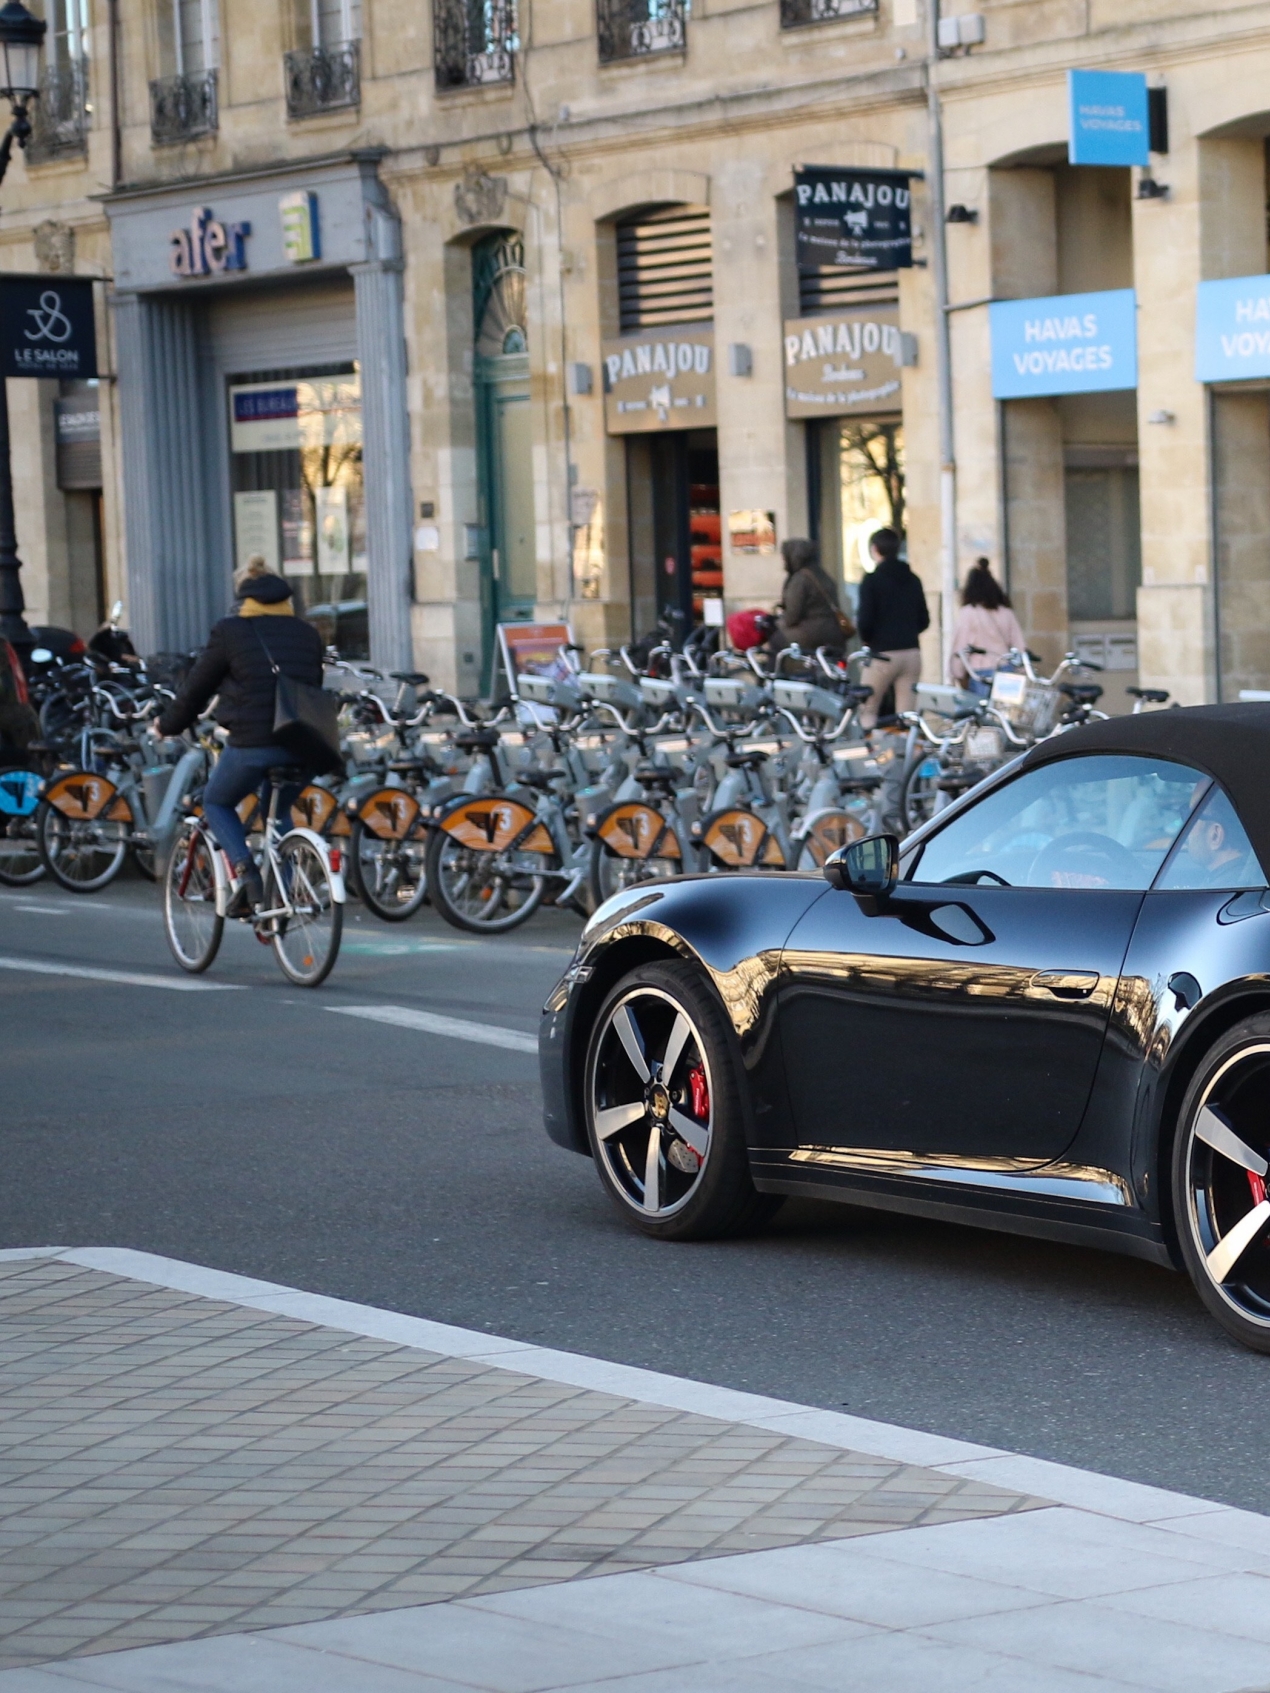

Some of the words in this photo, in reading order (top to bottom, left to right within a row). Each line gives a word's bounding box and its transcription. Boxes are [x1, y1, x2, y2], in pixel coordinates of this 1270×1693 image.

[797, 182, 909, 209] PANAJOU
[169, 206, 251, 276] afer
[1024, 313, 1098, 343] HAVAS
[14, 348, 32, 362] LE
[34, 348, 79, 362] SALON
[784, 322, 900, 366] PANAJOU
[606, 342, 710, 384] PANAJOU
[1013, 345, 1113, 376] VOYAGES
